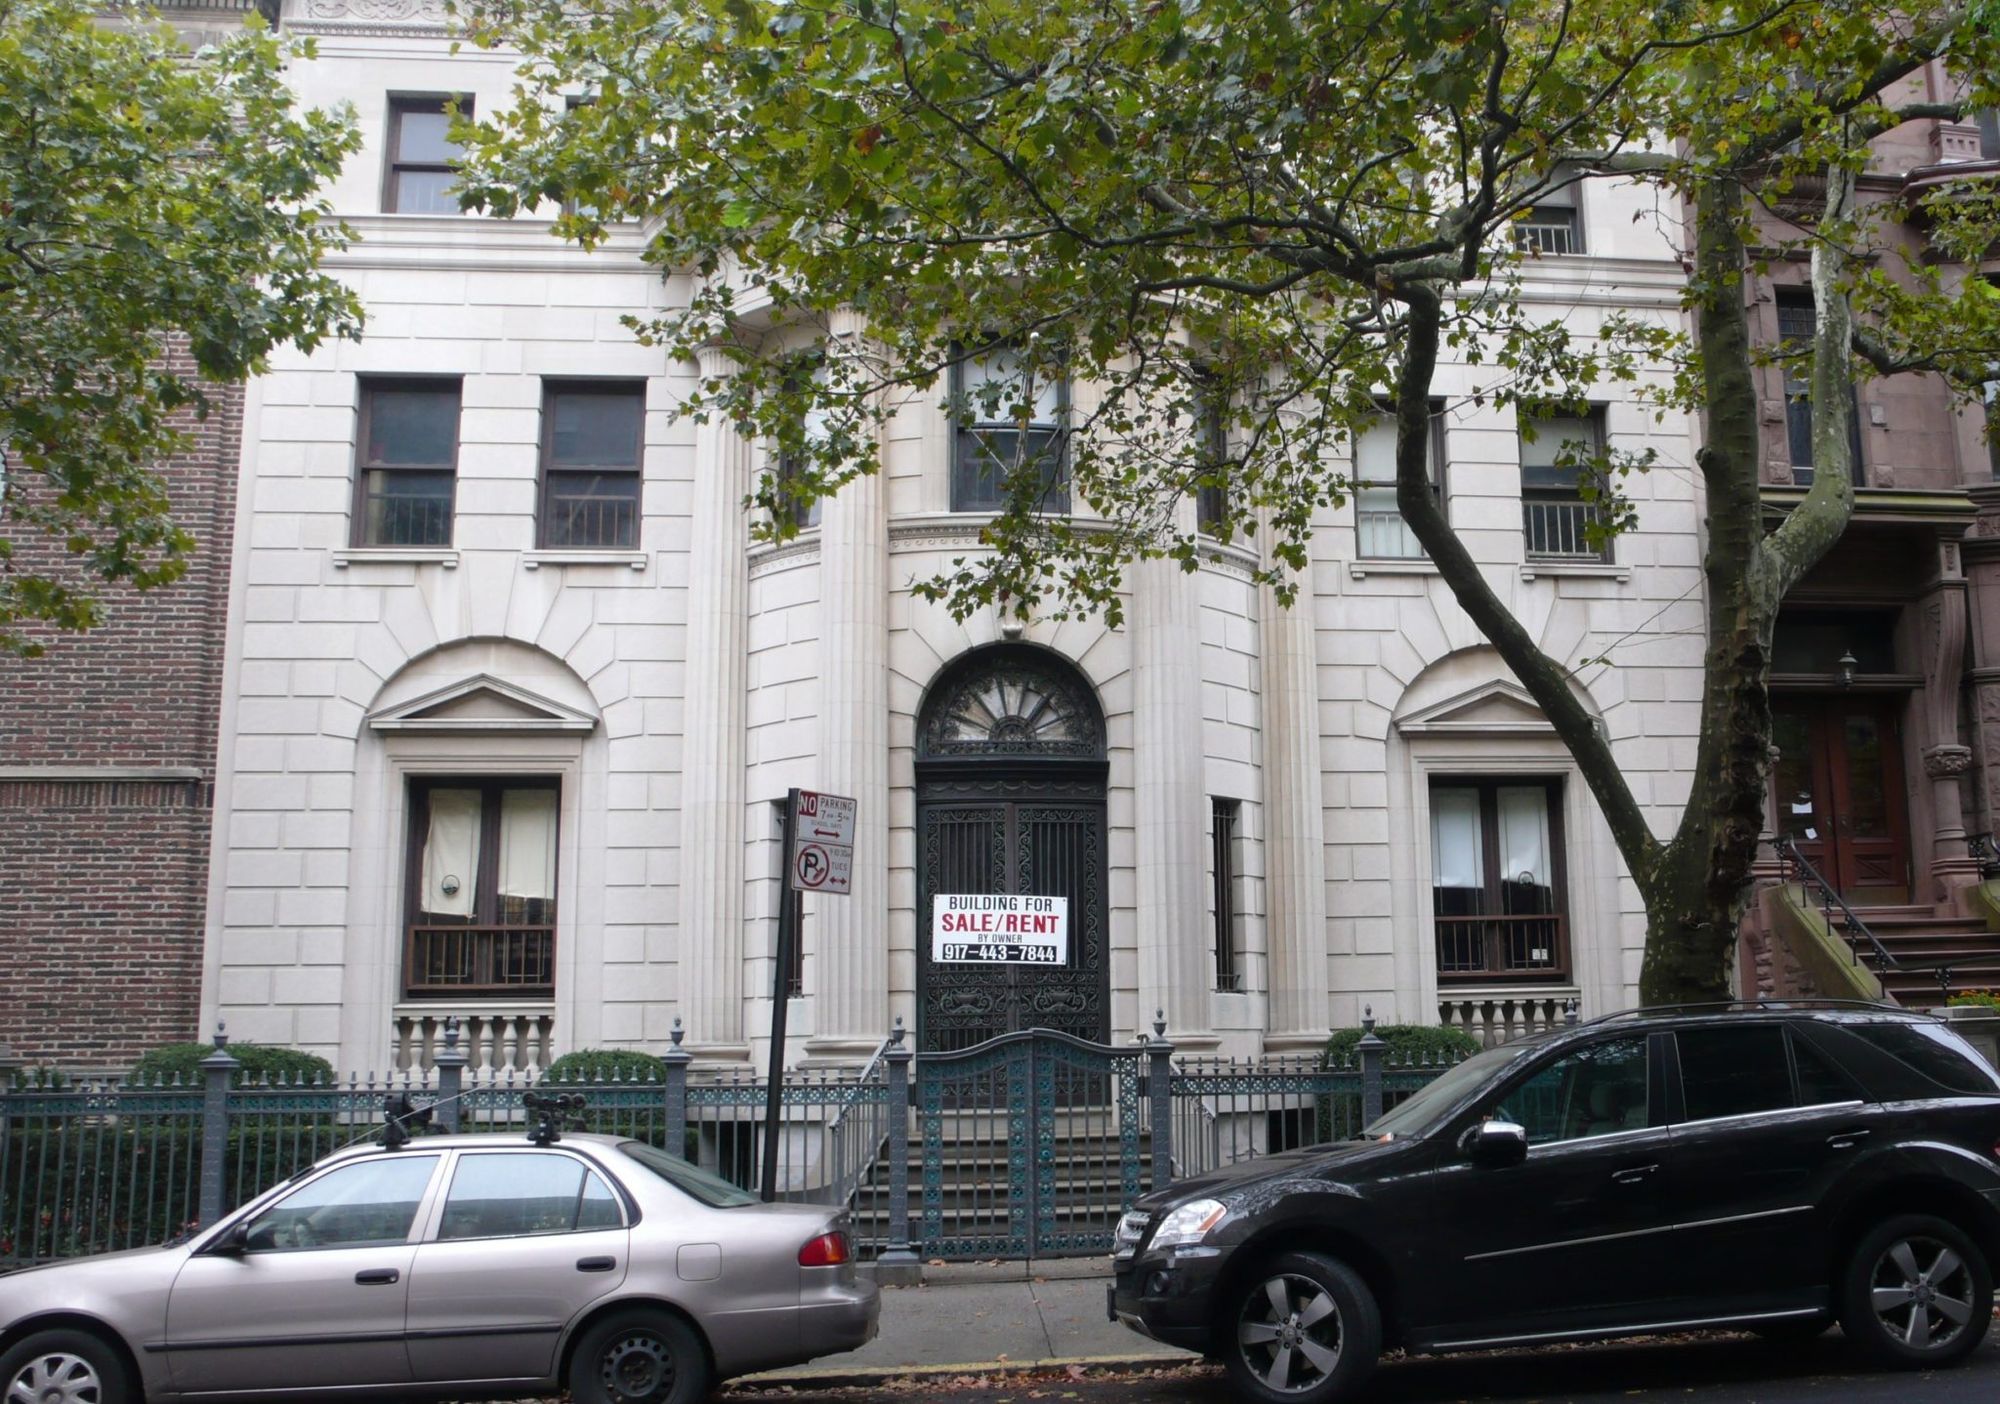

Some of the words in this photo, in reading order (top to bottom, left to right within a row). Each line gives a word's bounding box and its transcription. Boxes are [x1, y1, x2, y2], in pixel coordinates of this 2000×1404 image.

[799, 795, 816, 813] NO
[820, 797, 852, 812] PARKING
[949, 896, 1018, 911] BUILDING
[1025, 897, 1053, 912] FOR
[942, 913, 1059, 933] SALE/RENT
[978, 934, 988, 943] BY
[992, 934, 1023, 943] OWNER
[945, 944, 1055, 961] 917-443-7844
